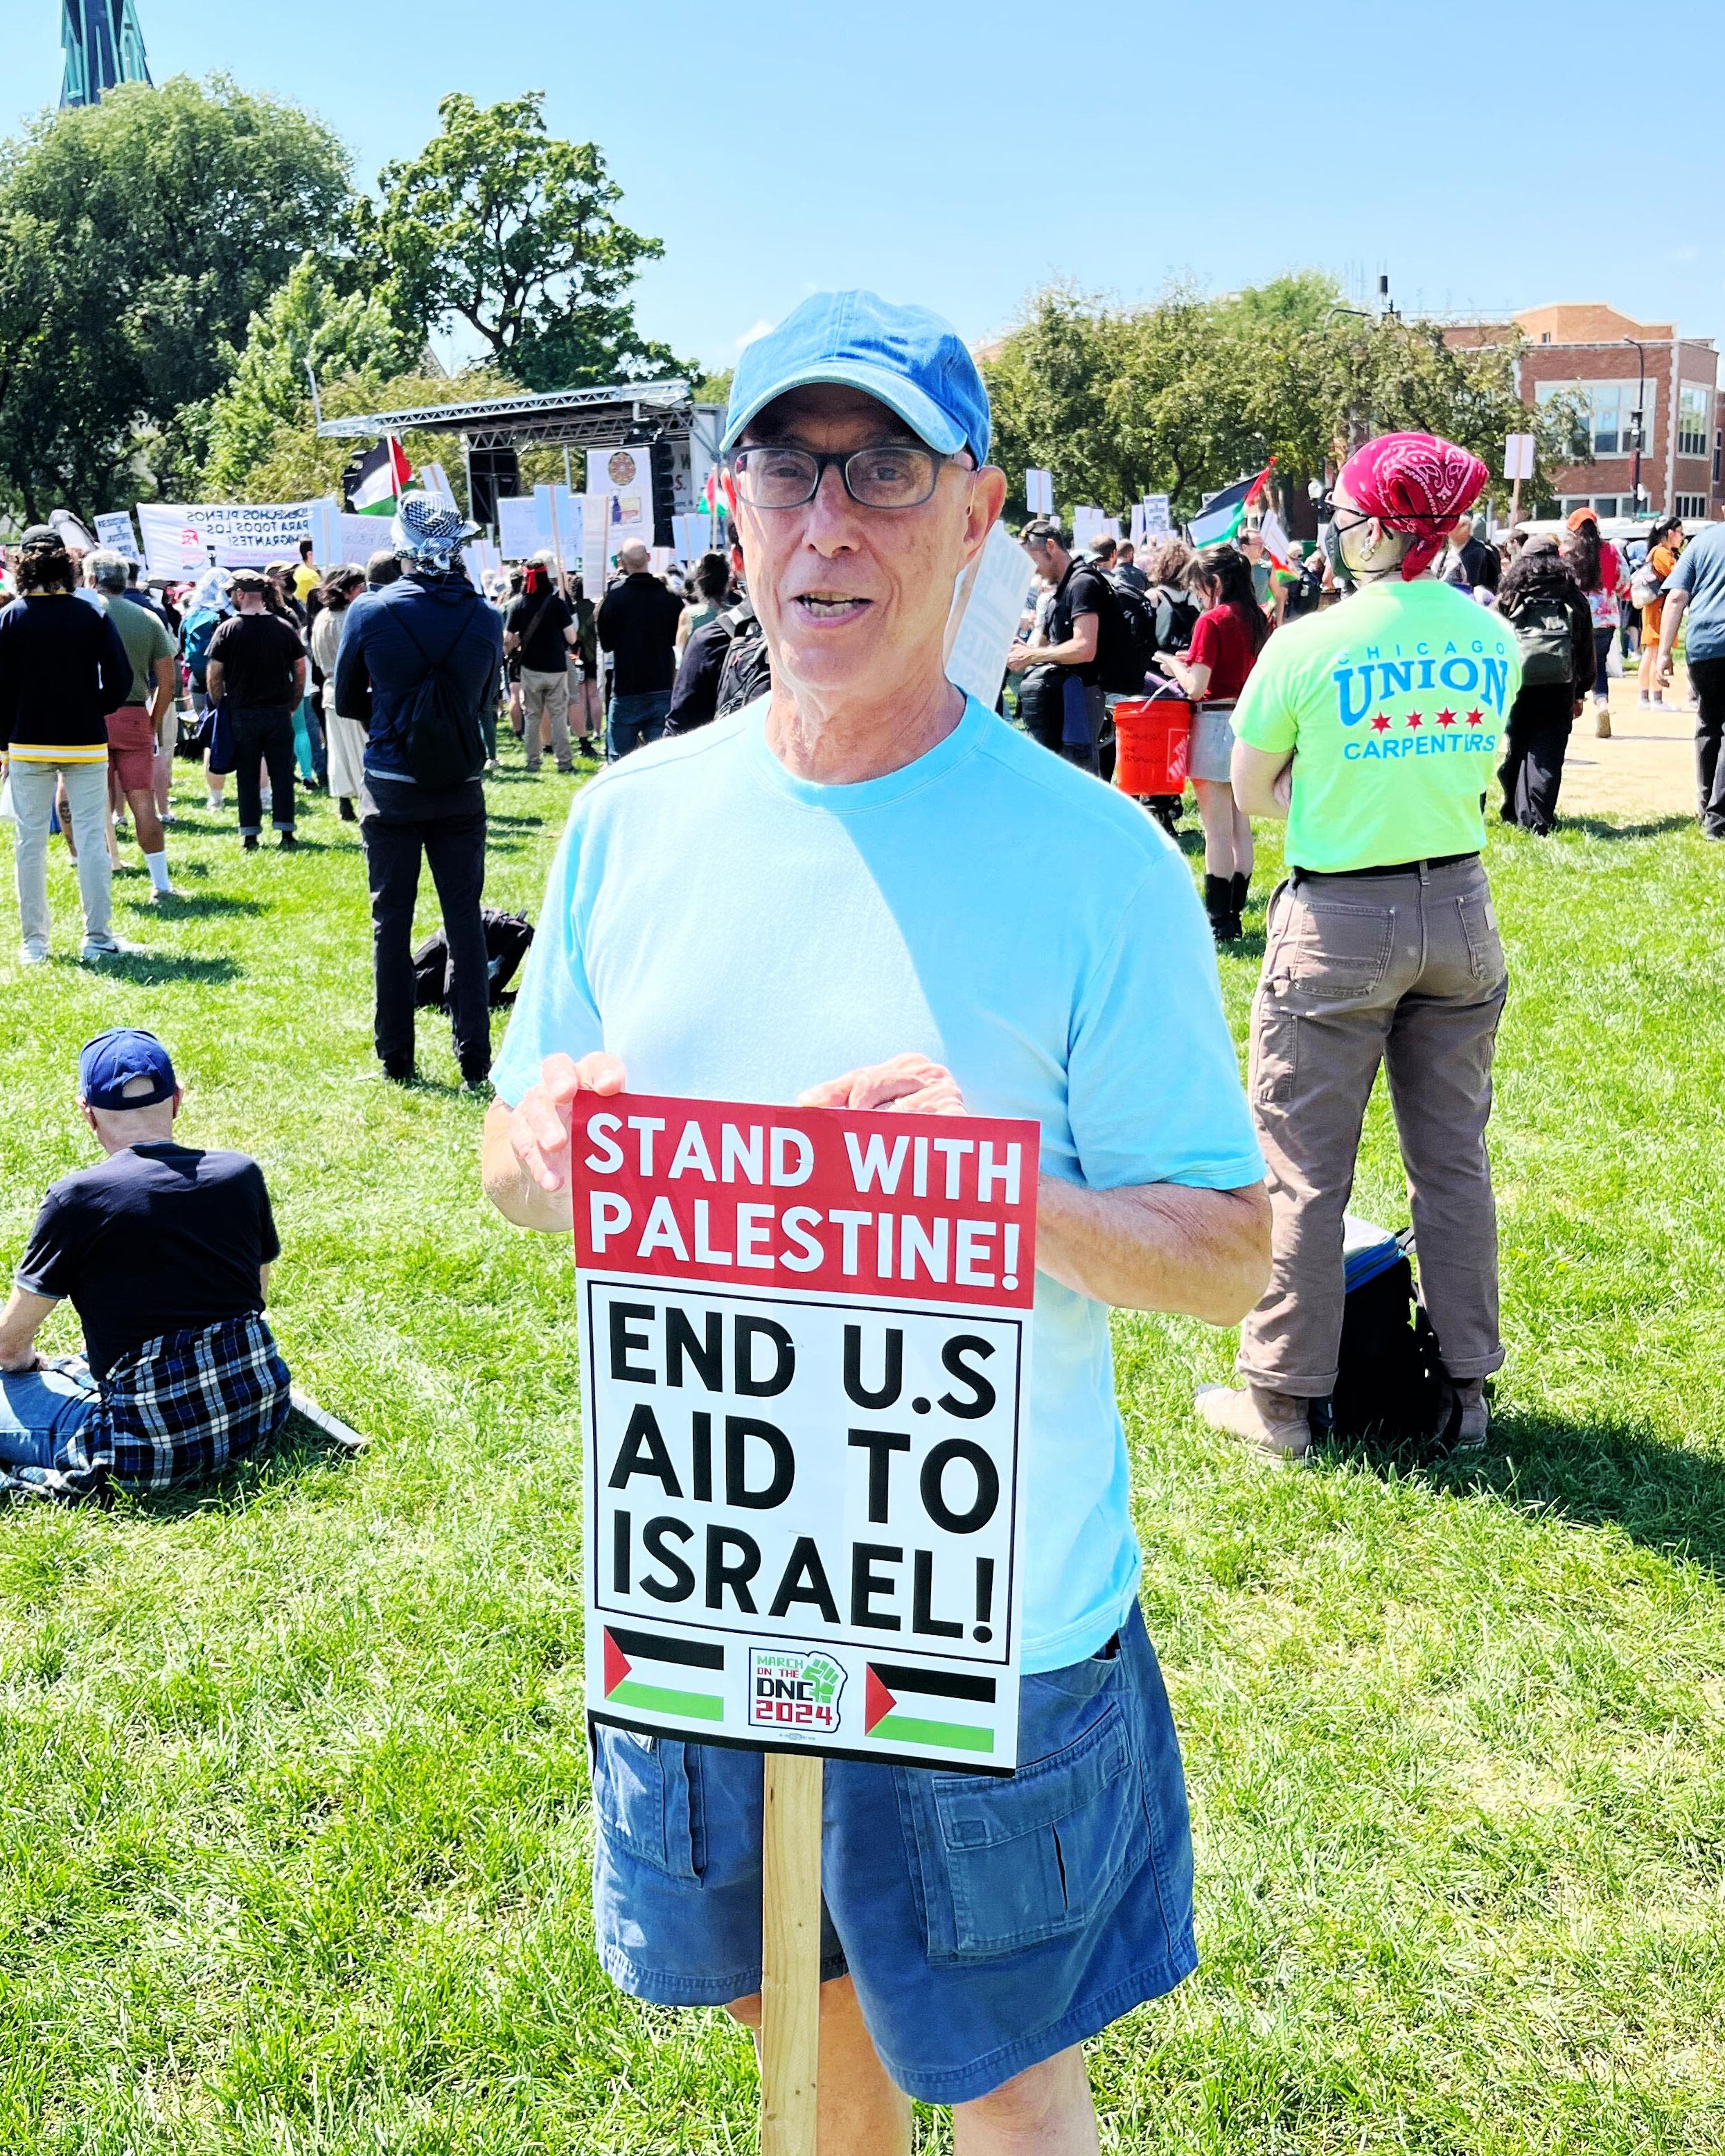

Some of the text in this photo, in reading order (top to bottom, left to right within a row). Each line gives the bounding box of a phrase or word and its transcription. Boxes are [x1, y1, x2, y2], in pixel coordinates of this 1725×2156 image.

[1338, 640, 1505, 664] CHICAGO
[1334, 657, 1507, 726] UNION
[585, 1113, 1022, 1205] STAND WITH
[590, 1190, 1020, 1291] PALESTINE!
[609, 1300, 996, 1420] END U.S
[608, 1403, 1000, 1535] AID TO
[614, 1509, 995, 1643] ISRAEL!
[757, 1655, 804, 1669] MARCH
[757, 1667, 799, 1678] ON THE
[757, 1677, 813, 1702] DNC
[756, 1699, 833, 1726] 2024
